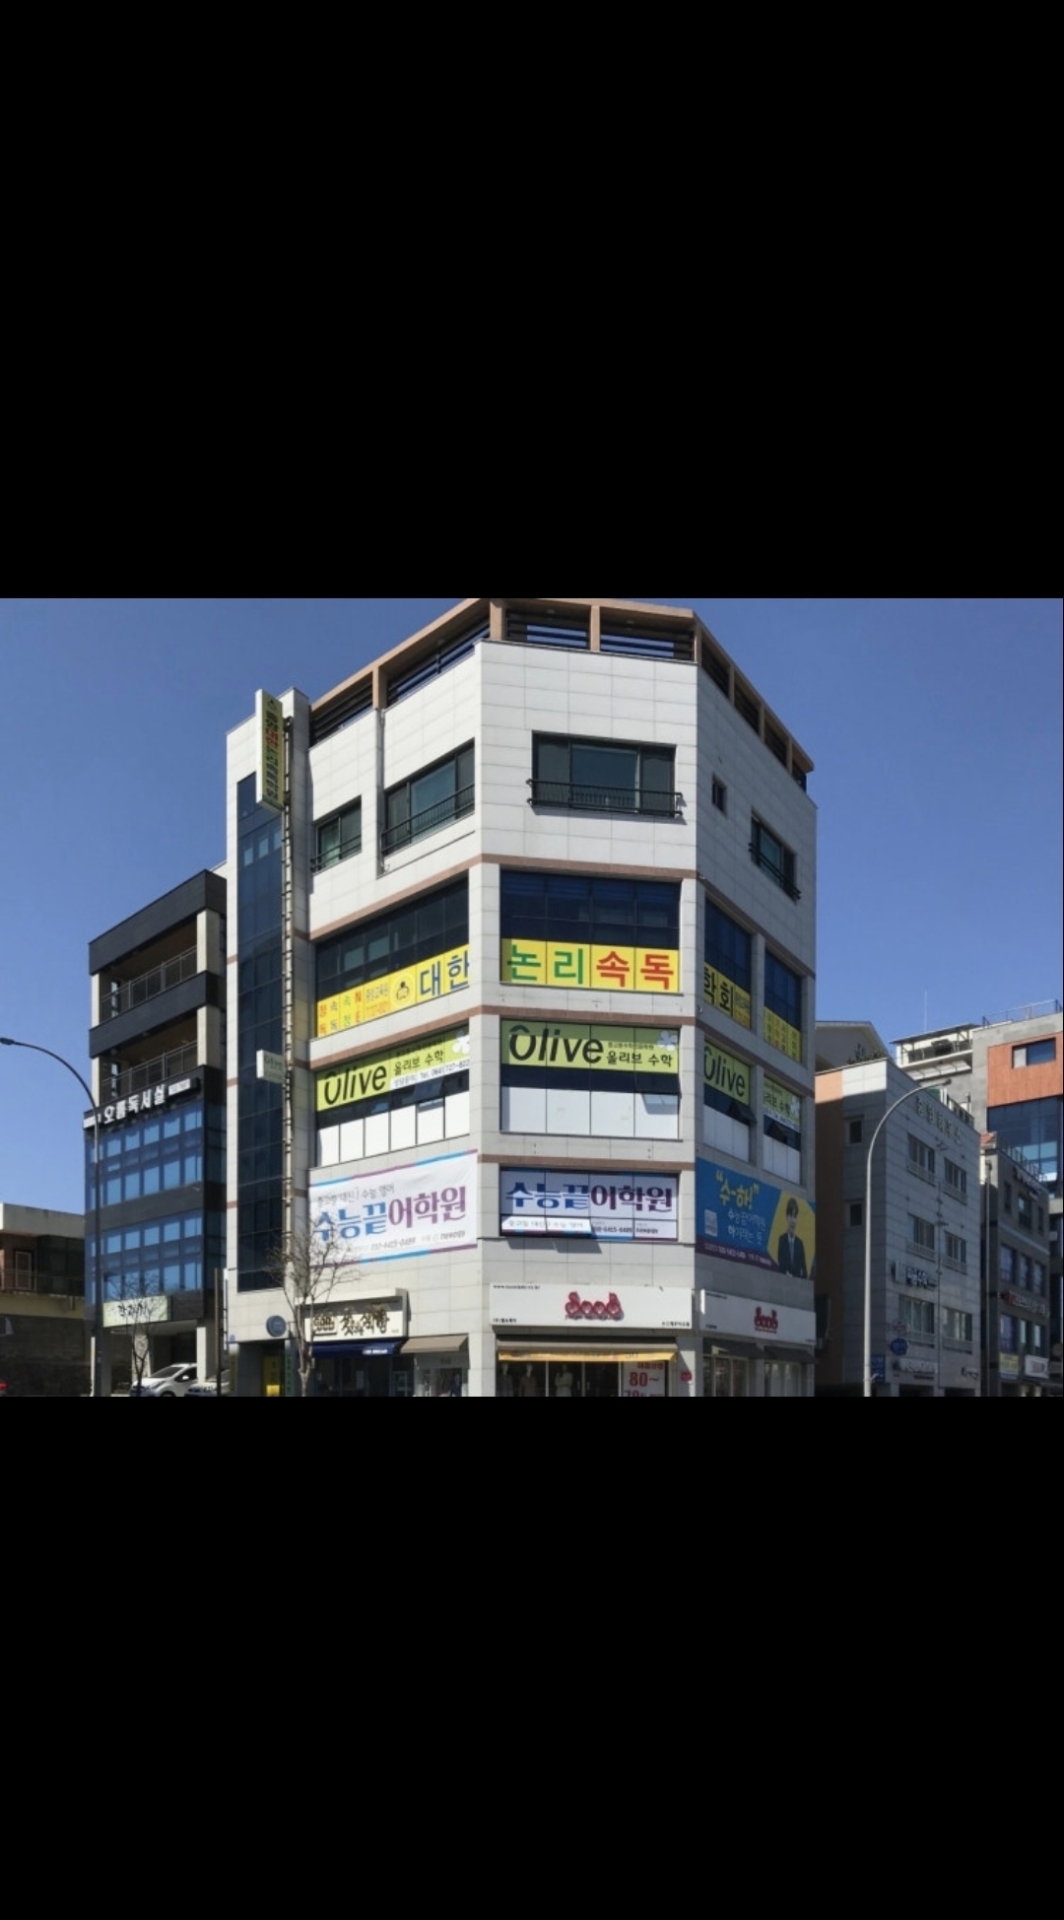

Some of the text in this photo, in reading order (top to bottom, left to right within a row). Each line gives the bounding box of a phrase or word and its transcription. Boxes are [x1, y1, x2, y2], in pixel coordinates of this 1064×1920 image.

[394, 1050, 444, 1076] 올리브 수학
[508, 1025, 604, 1064] Olive
[607, 1050, 672, 1068] 올리브 수학
[324, 1063, 387, 1105] Olive
[704, 1046, 745, 1097] Olive
[313, 1185, 466, 1242] 수능끝어학원
[506, 1181, 672, 1213] 수능끝어학원
